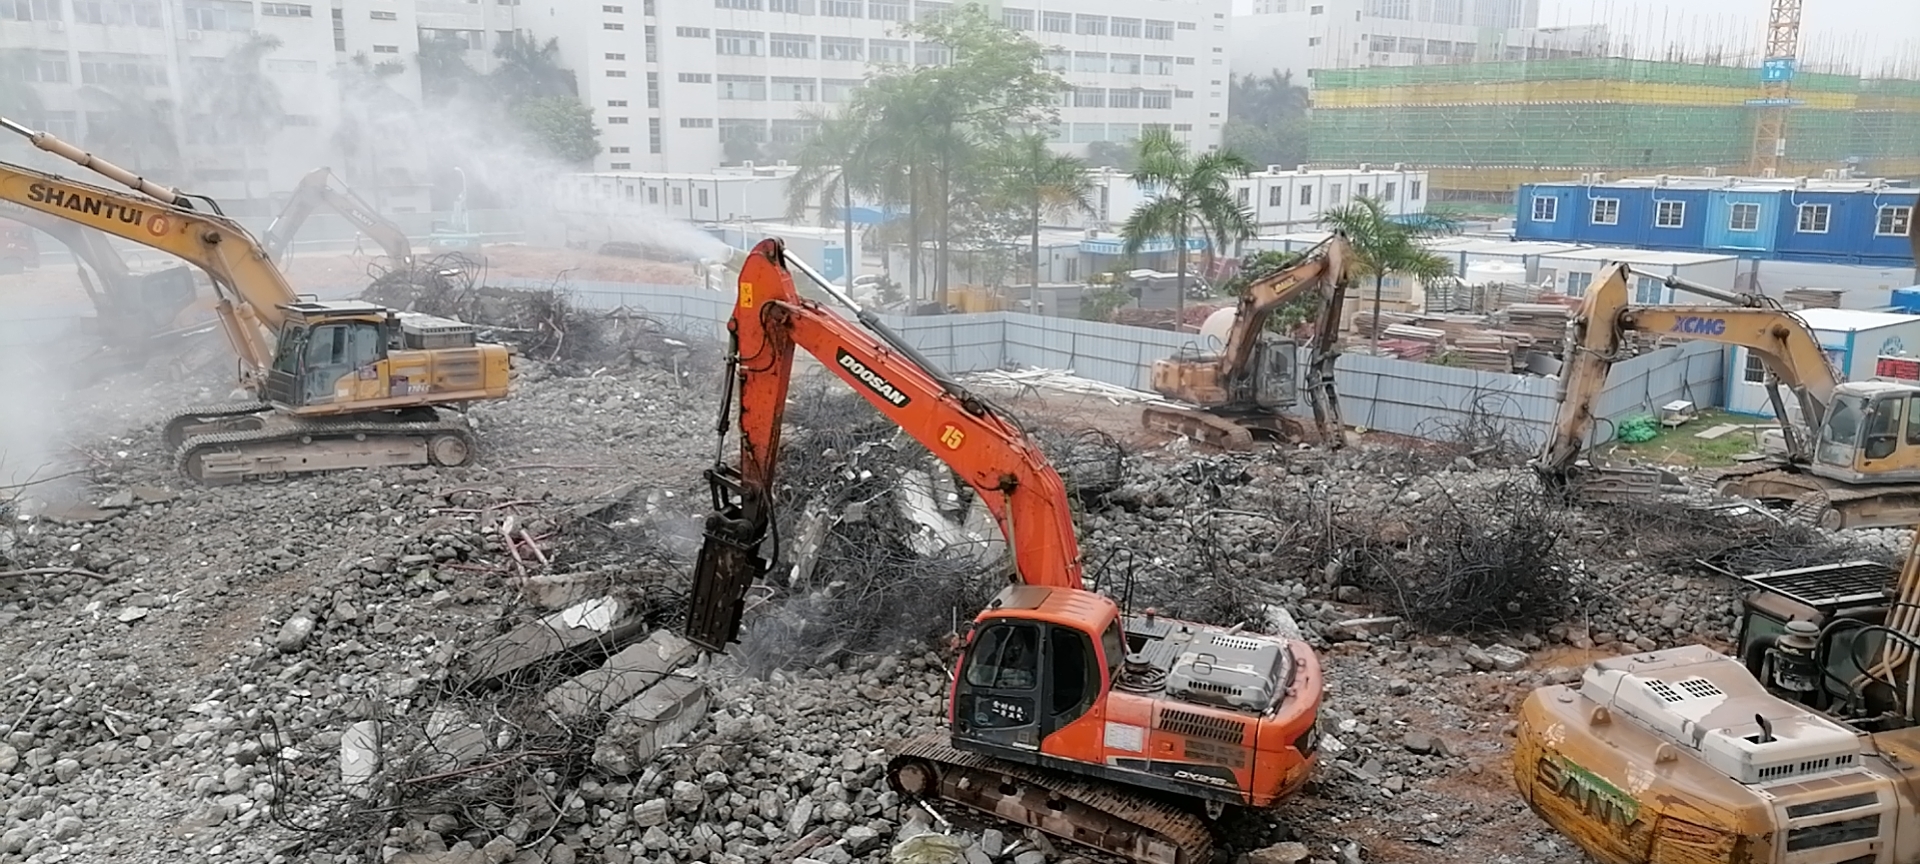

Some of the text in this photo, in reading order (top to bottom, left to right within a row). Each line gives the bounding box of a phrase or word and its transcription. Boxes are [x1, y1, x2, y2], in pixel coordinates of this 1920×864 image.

[27, 183, 143, 226] SHANTUI
[152, 219, 163, 233] 6
[1669, 315, 1726, 336] XCMG
[839, 354, 906, 404] DOOSAN
[940, 425, 965, 450] 15
[1536, 757, 1646, 845] SANY
